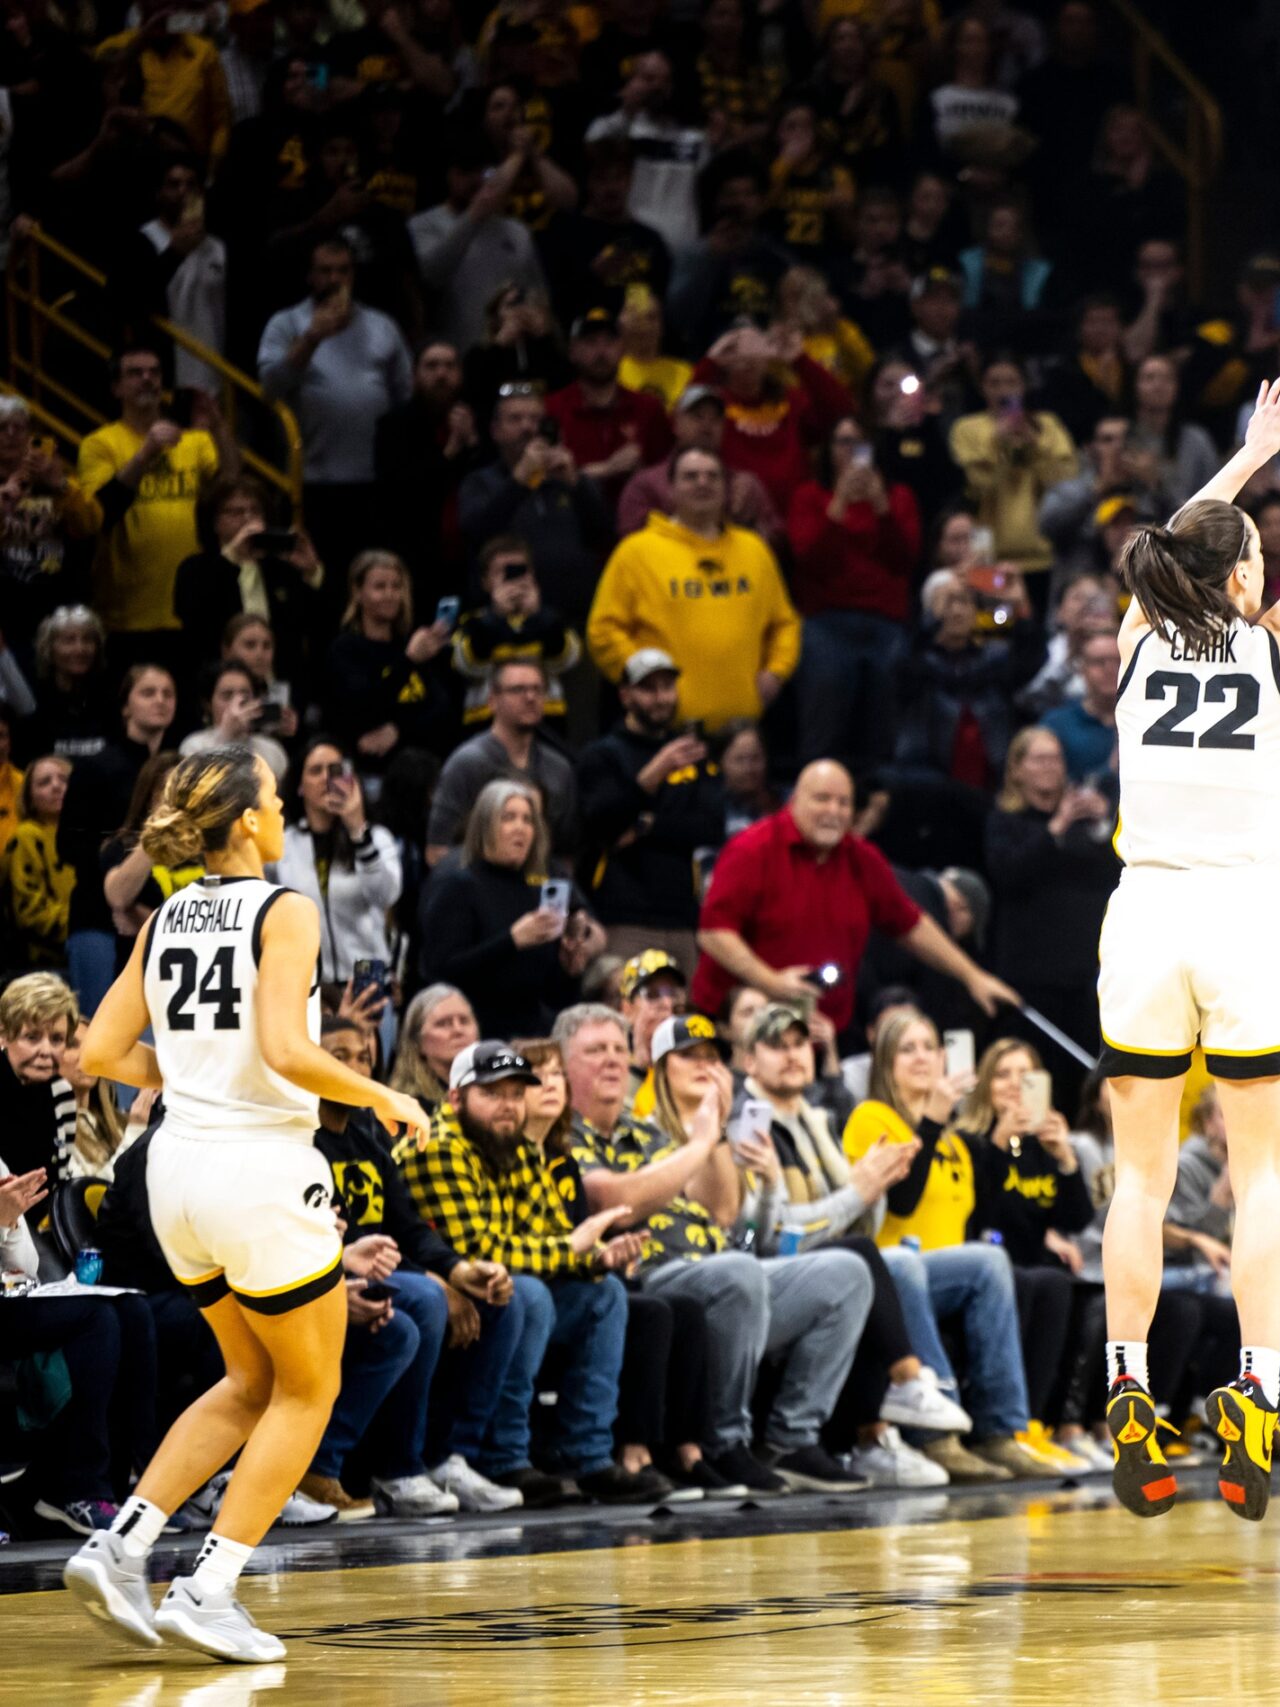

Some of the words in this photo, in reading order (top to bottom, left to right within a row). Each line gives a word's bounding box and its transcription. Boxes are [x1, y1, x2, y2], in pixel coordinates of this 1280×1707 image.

[670, 575, 749, 599] IOWA
[1142, 670, 1260, 750] 22
[162, 898, 243, 934] MARSHALL
[159, 946, 241, 1031] 24
